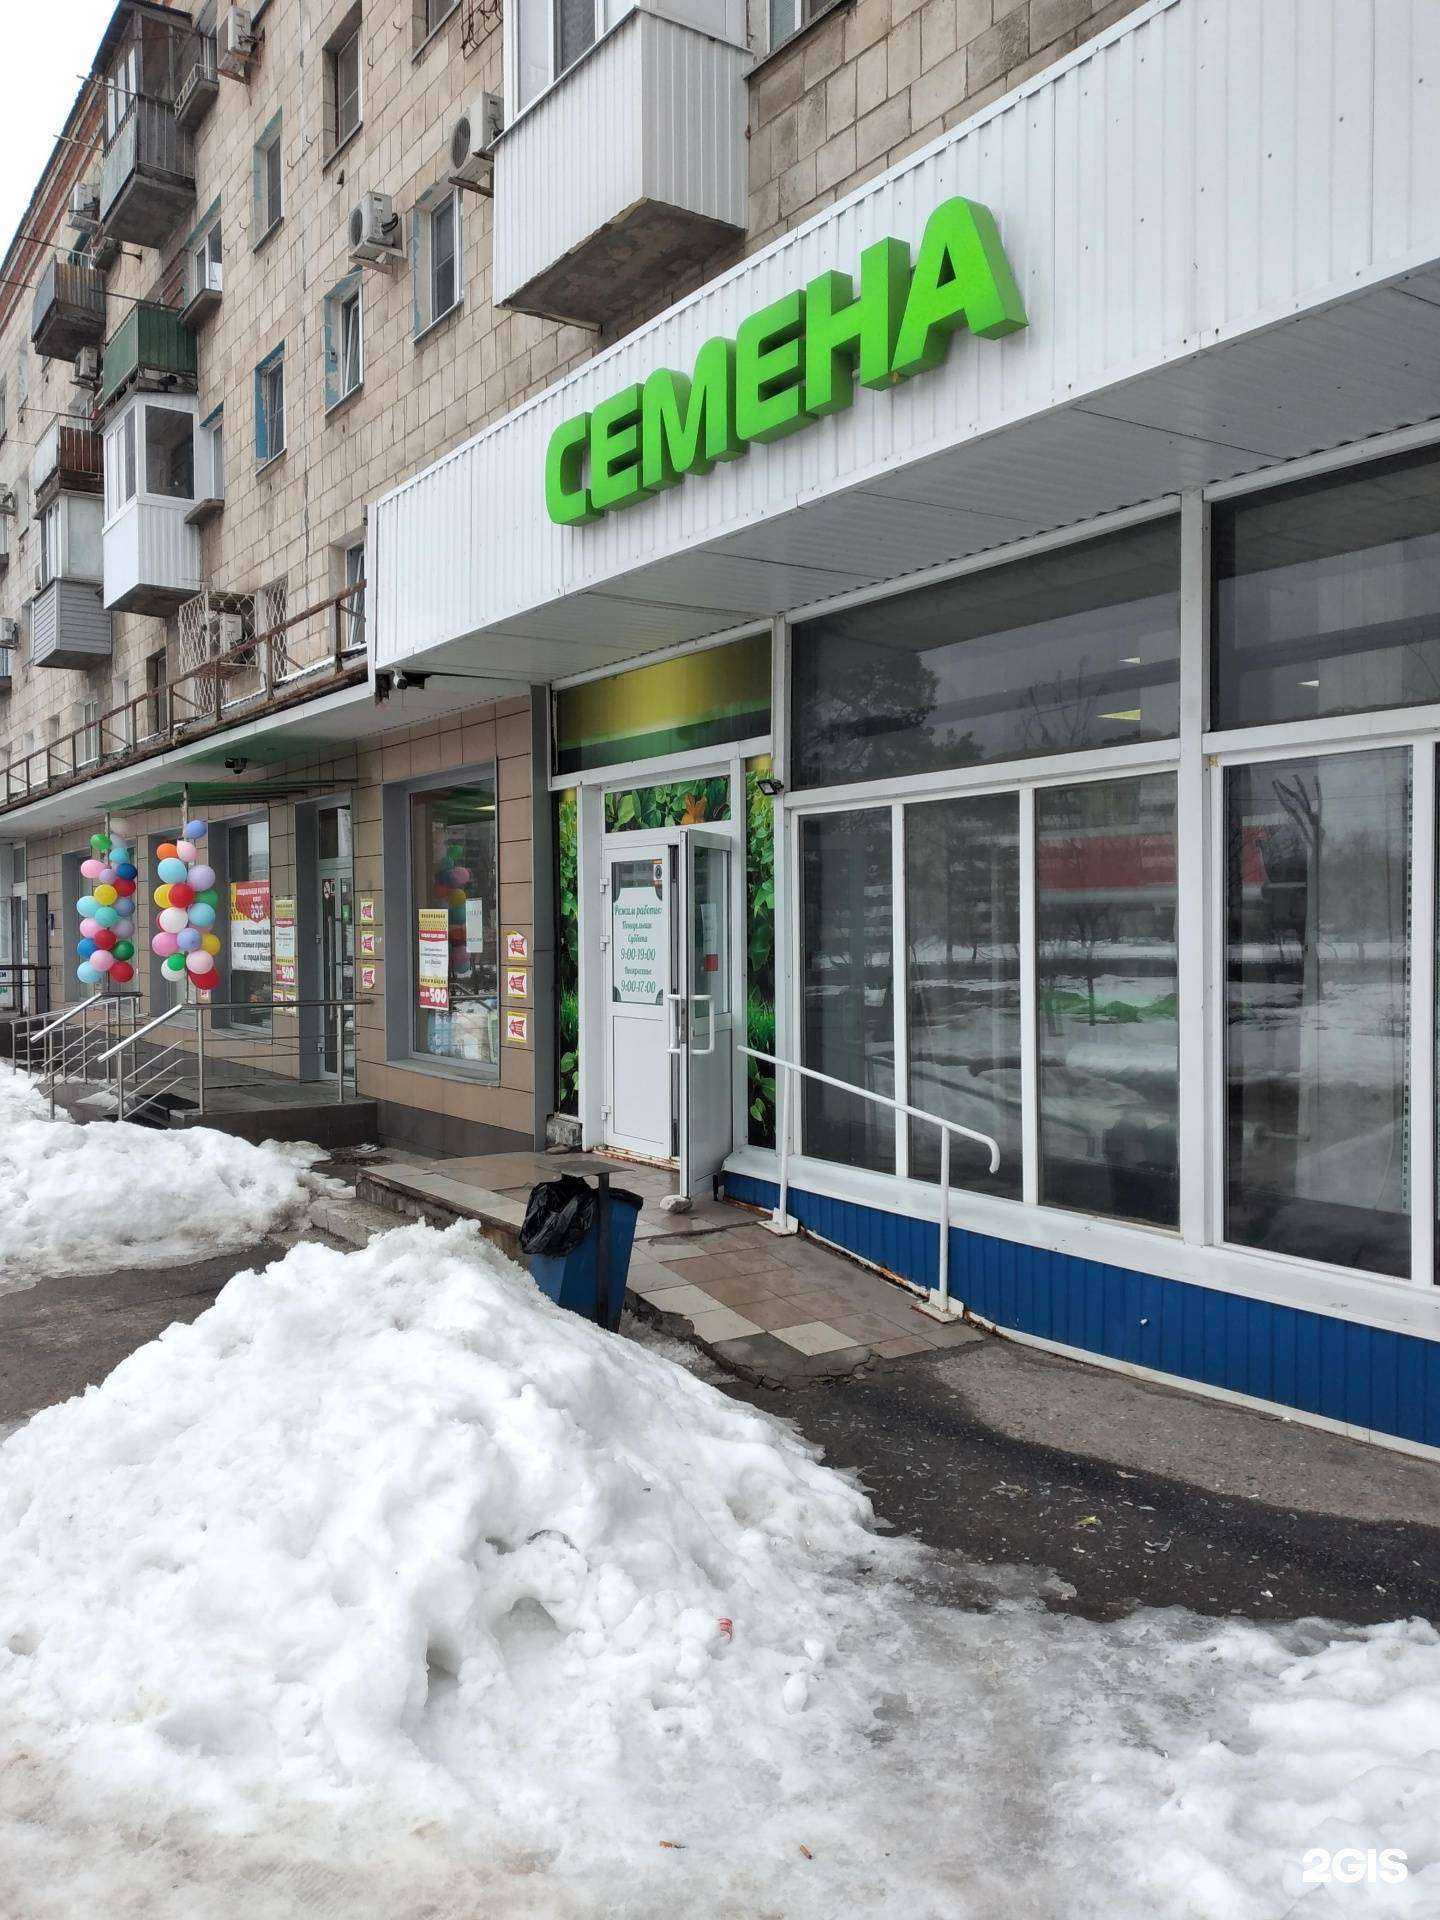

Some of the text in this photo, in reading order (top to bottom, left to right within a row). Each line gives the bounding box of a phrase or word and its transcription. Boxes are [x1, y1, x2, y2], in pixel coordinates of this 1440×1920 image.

[546, 196, 1029, 527] СЕМЕНА
[614, 905, 636, 916] Режим
[620, 947, 656, 961] 9:00-19:00
[620, 980, 656, 994] 9:00-17:00
[430, 986, 447, 1004] 500
